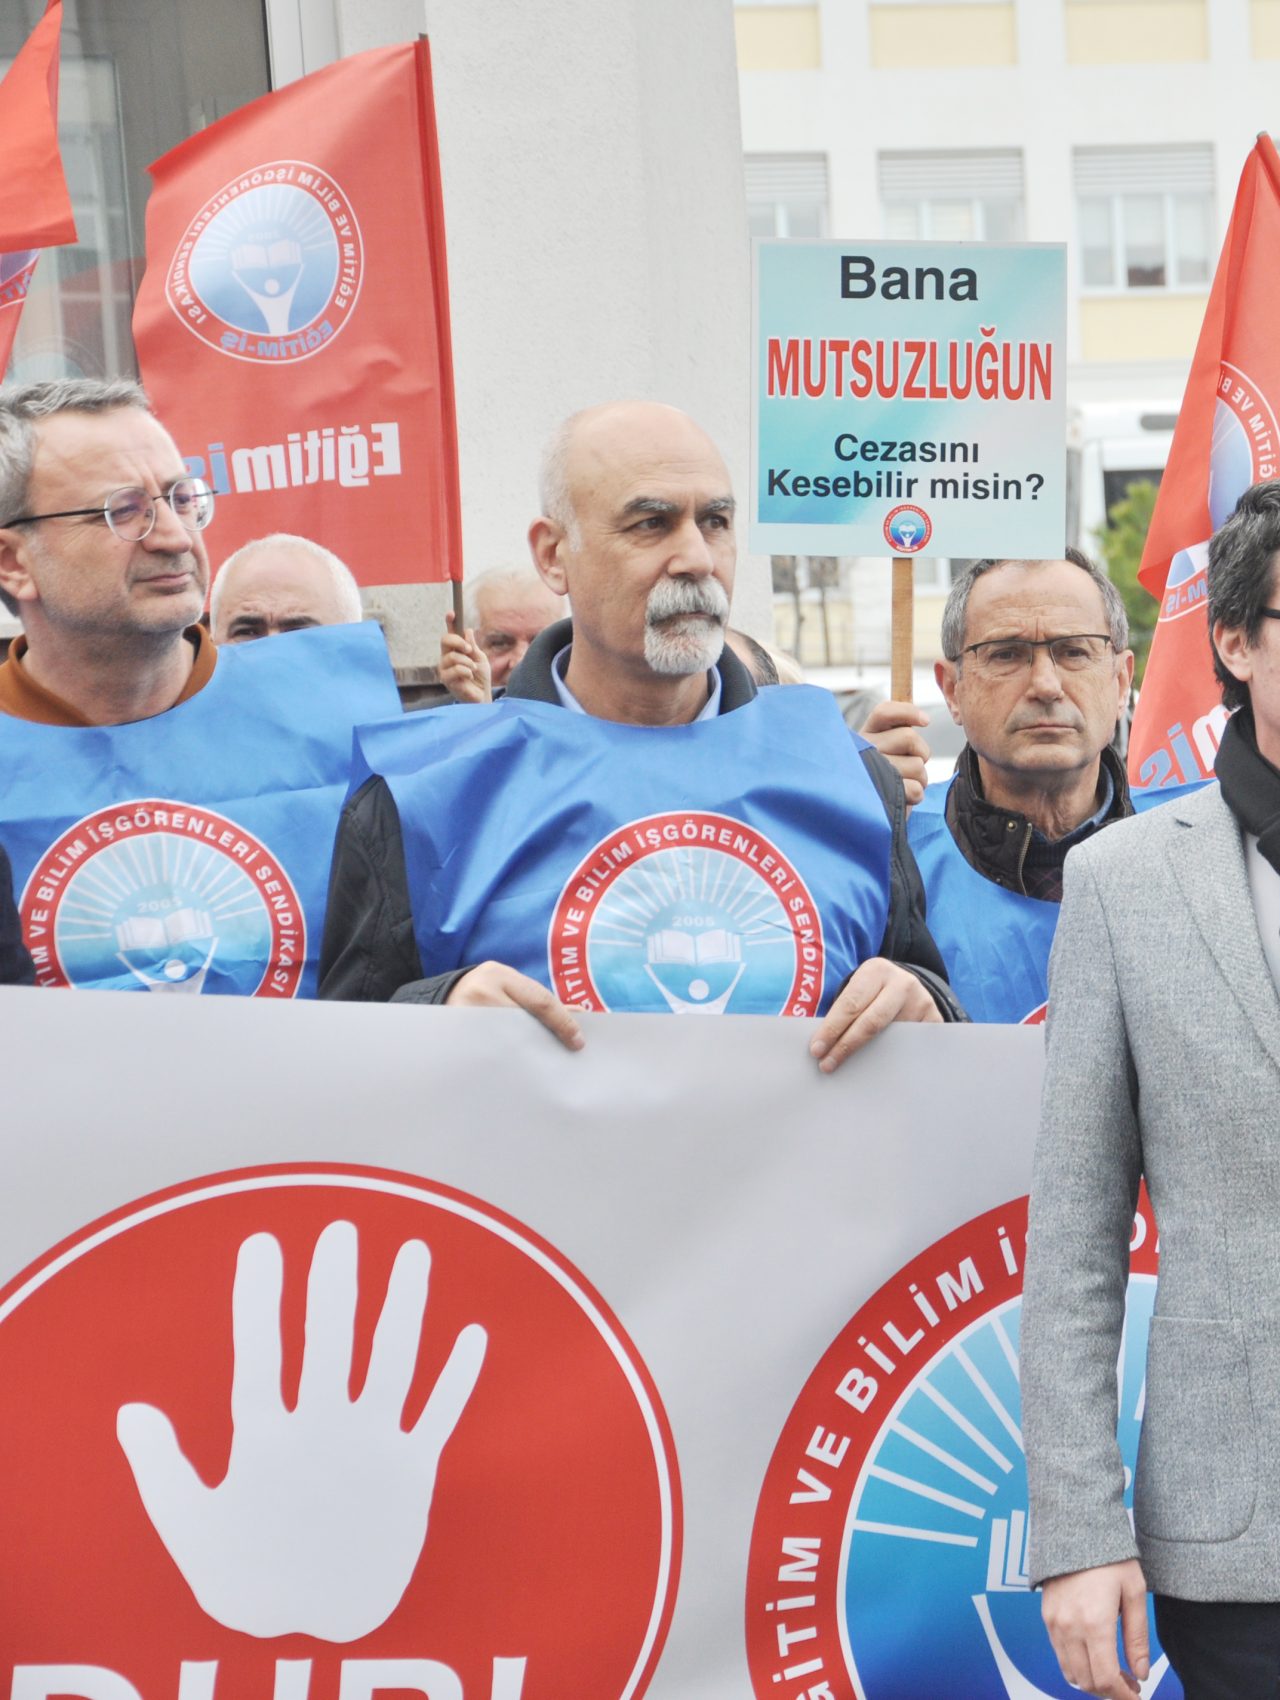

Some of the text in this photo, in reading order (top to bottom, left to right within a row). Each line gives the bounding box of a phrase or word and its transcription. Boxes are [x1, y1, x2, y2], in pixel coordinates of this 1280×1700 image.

[840, 254, 979, 301] Bana
[767, 326, 1052, 401] MUTSUZLUĞUN
[834, 433, 979, 463] Cezasını
[767, 468, 1045, 500] Kesebilir misin?
[87, 807, 260, 865] İŞGÖRENLERİ
[37, 839, 88, 902] BİLİM
[29, 909, 49, 938] VE
[255, 865, 300, 993] SENDİKASI
[562, 906, 585, 938] VE
[576, 841, 633, 903] BİLİM
[633, 819, 796, 893] İŞGÖRENLERİ
[789, 896, 819, 1017] SENDİKAS
[671, 915, 716, 927] 2005
[789, 1425, 851, 1505] VE
[835, 1256, 985, 1414] BİLİM
